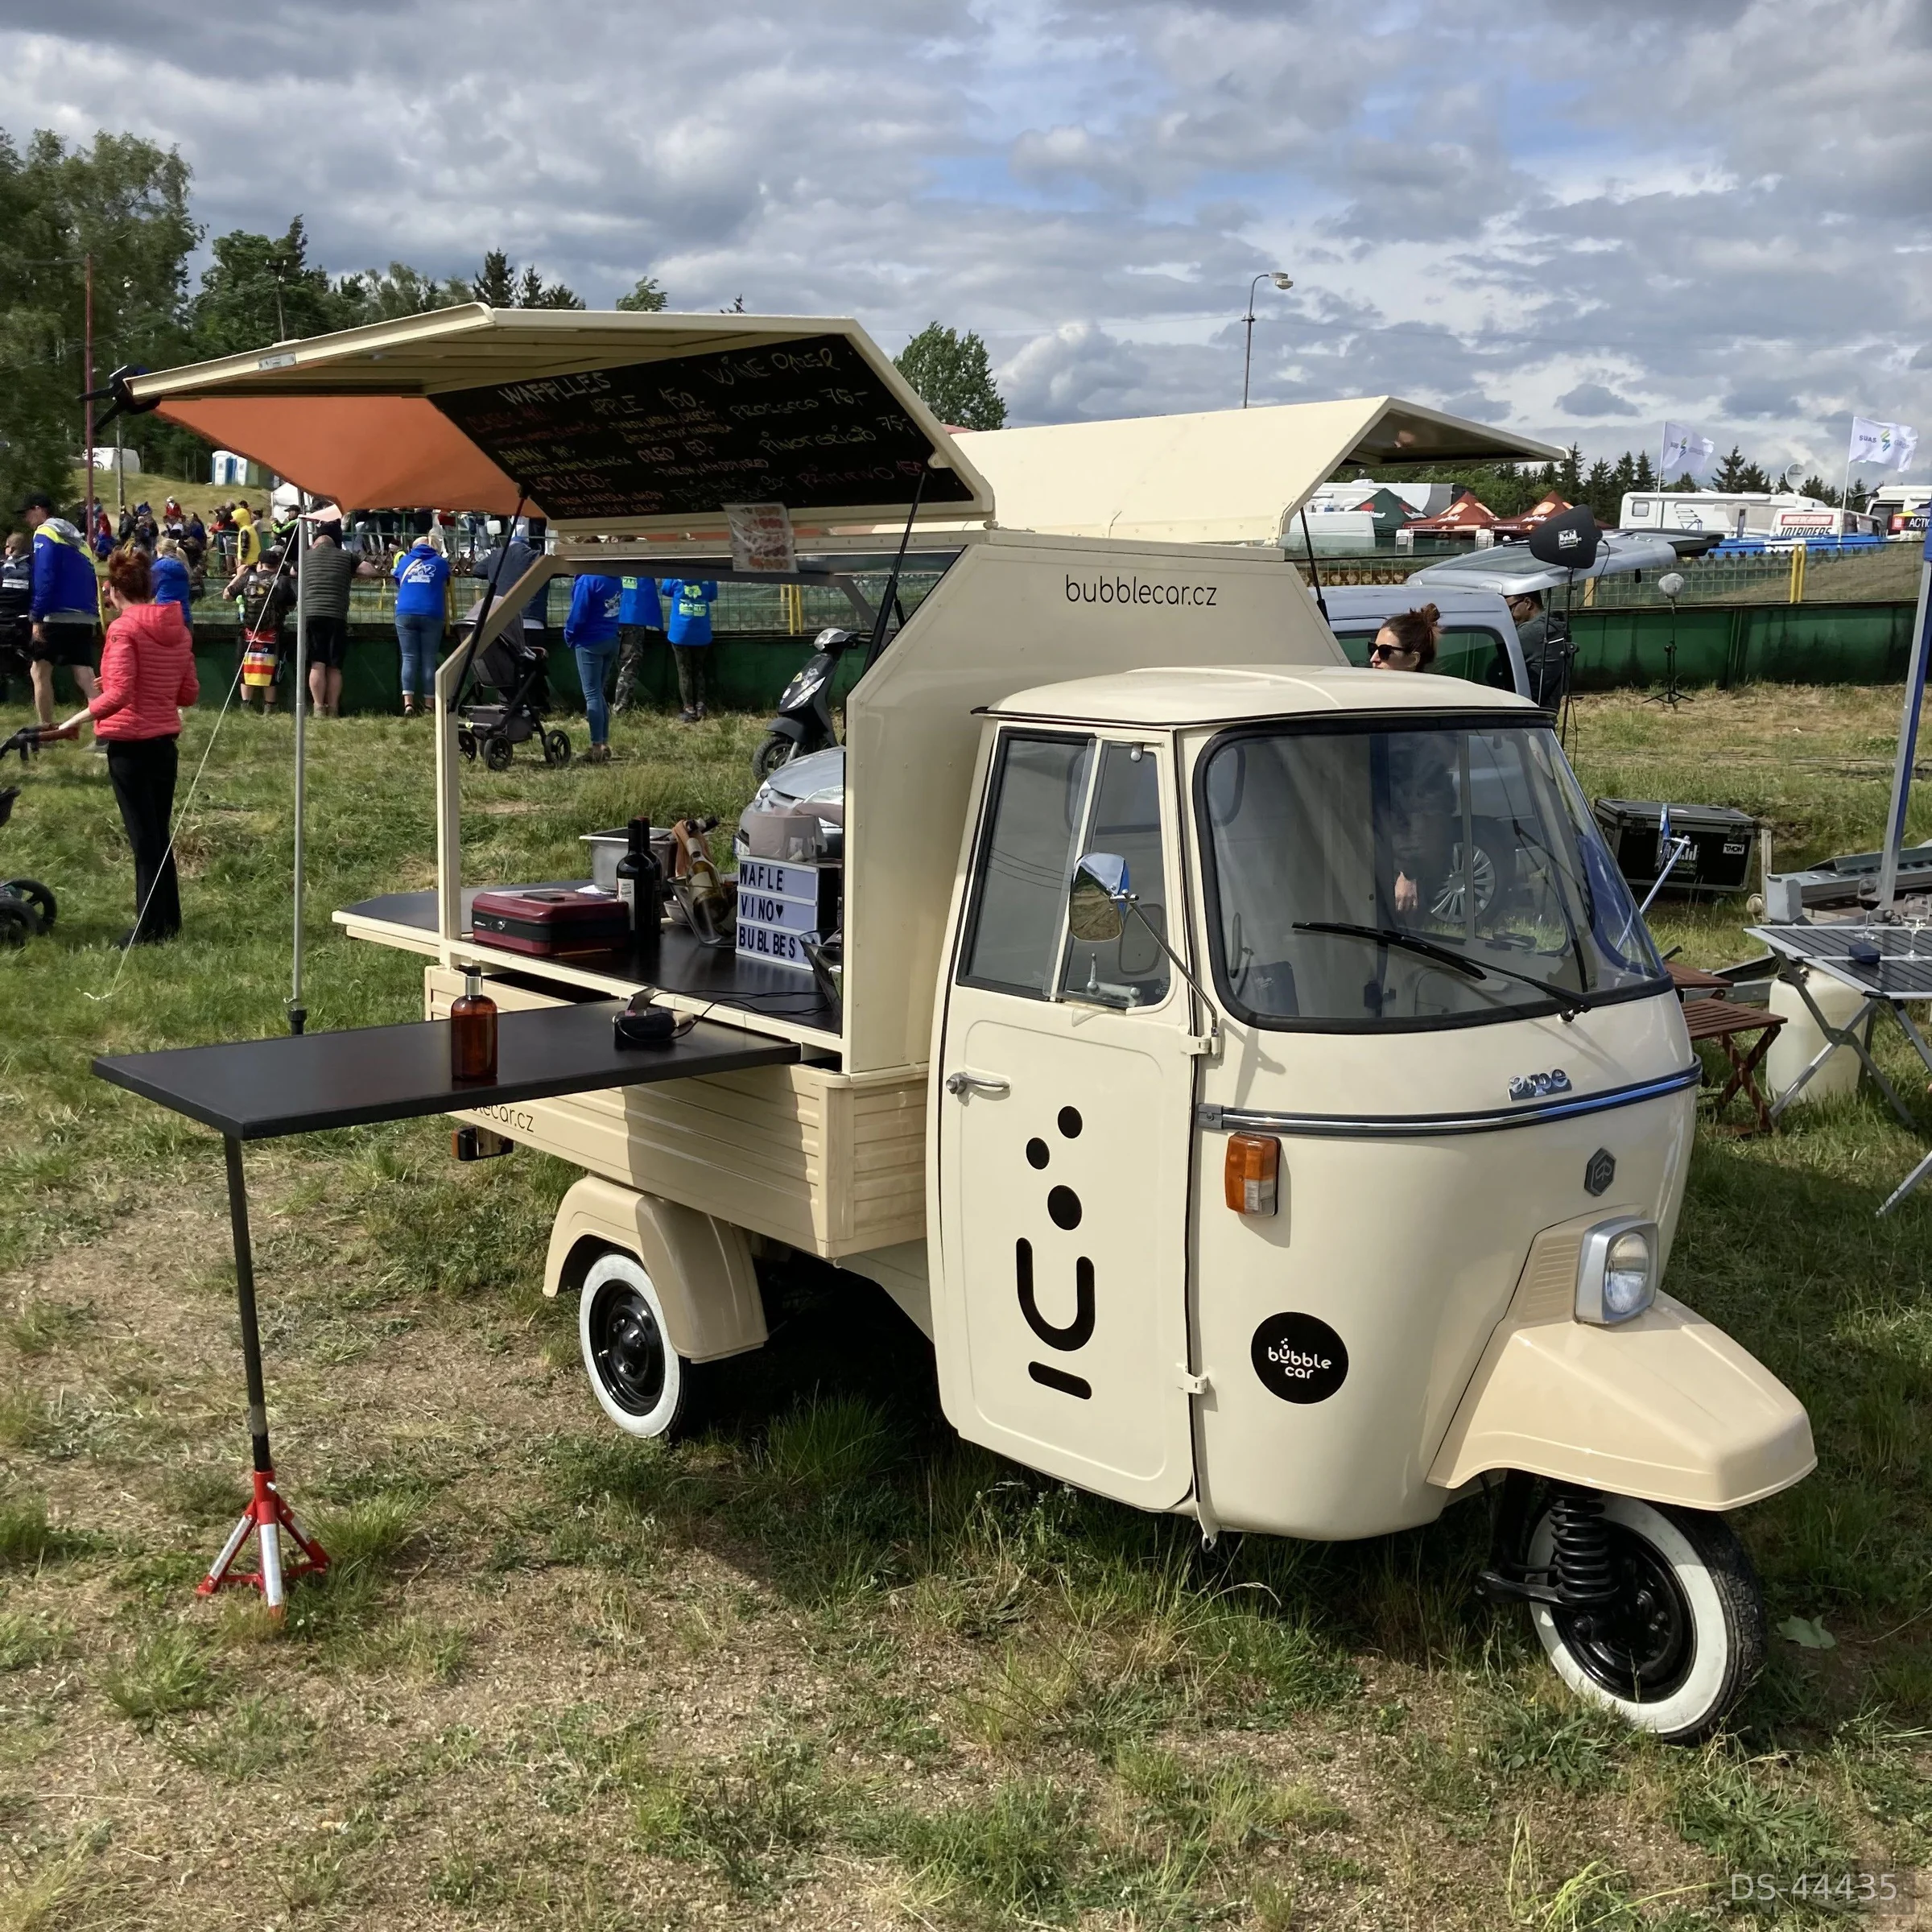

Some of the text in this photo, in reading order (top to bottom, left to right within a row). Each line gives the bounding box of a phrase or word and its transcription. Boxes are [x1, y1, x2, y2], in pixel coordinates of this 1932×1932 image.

[1066, 574, 1217, 605] bubblecar.cz
[741, 863, 783, 891] WAFLE
[741, 895, 774, 922] VINO
[1285, 1366, 1314, 1379] car
